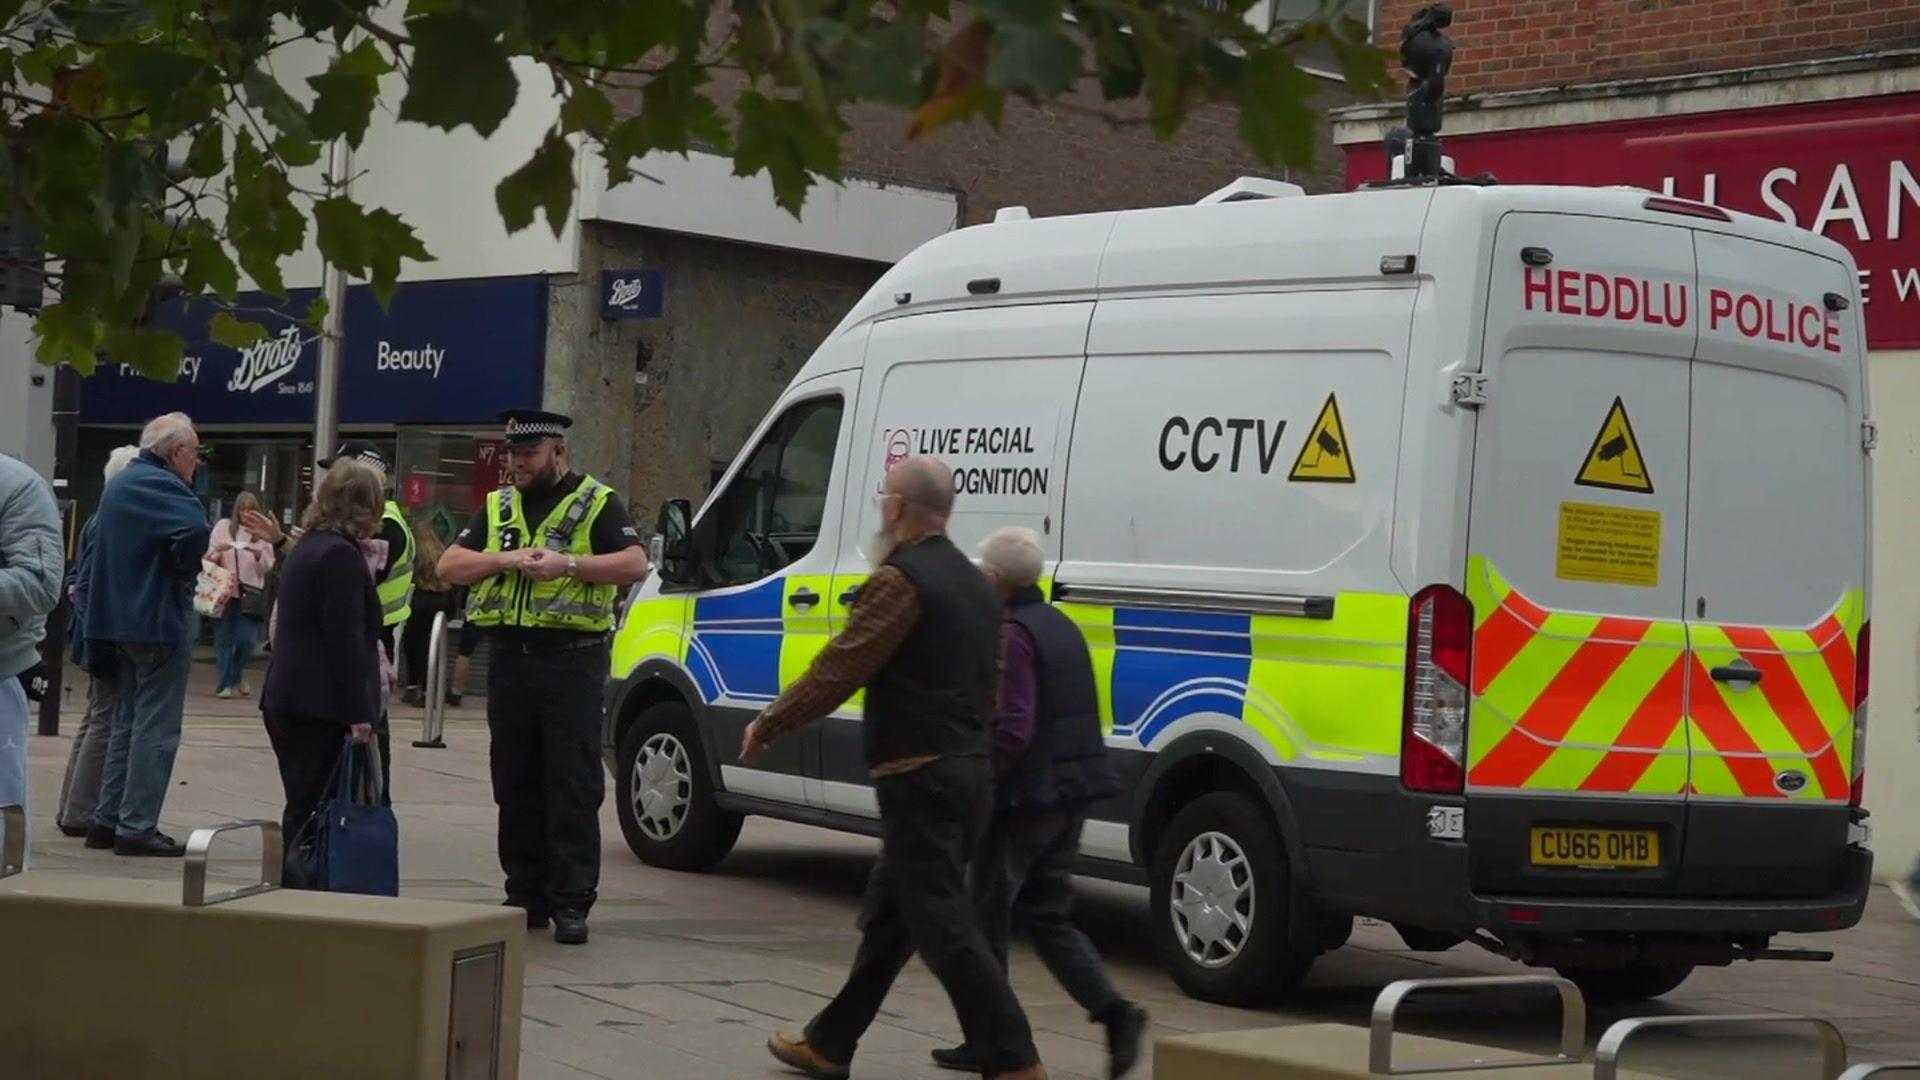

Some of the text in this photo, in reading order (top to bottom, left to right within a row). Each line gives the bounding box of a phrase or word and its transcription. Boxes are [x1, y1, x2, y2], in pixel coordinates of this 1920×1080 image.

[1524, 267, 1841, 353] HEDDLU POLICE
[227, 324, 301, 393] Boots
[377, 340, 446, 379] Beauty
[919, 426, 1035, 454] LIVE FACIAL
[1158, 415, 1287, 474] CCTV
[951, 466, 1049, 496] OGNITION
[1541, 832, 1649, 861] CU66 OHB
